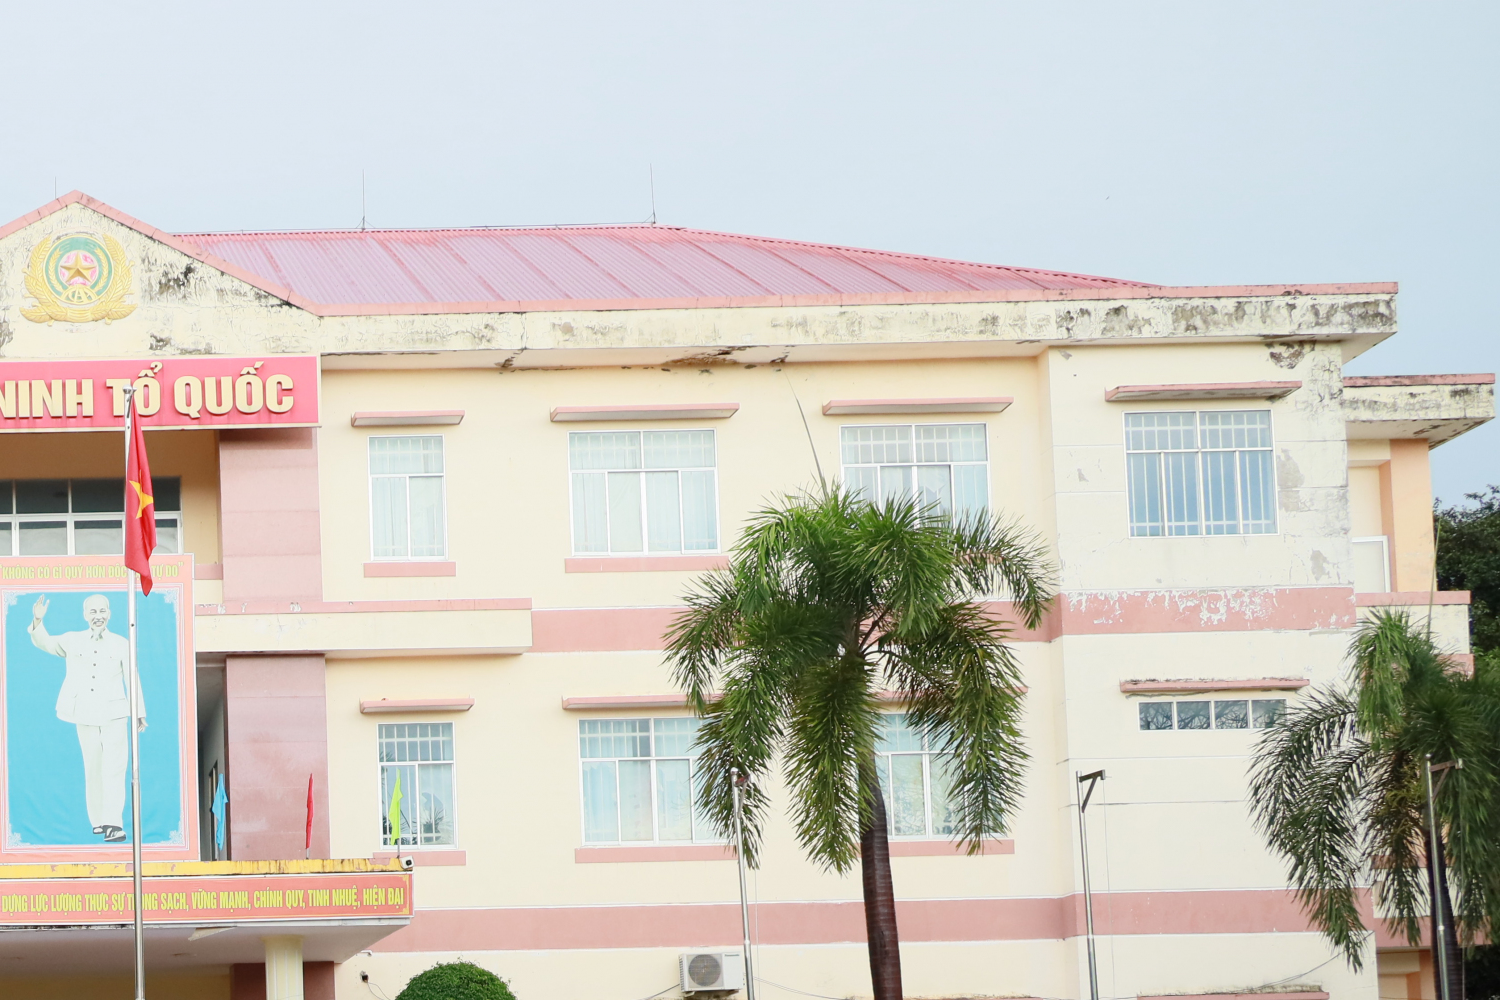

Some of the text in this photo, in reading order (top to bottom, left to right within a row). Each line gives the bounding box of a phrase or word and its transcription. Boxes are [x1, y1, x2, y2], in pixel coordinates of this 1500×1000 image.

[105, 361, 162, 417] TỔ
[173, 360, 294, 419] QUỐC
[36, 563, 50, 579] CÓ
[52, 564, 62, 579] GÌ
[65, 563, 84, 580] QUÝ
[85, 563, 106, 579] HƠN
[2, 893, 28, 916] DỰNG
[30, 892, 49, 916] LỰC
[51, 892, 83, 916] LƯỢNG
[84, 892, 109, 916] THỰC
[111, 891, 126, 915] SỰ
[160, 892, 190, 914] SẠCH,
[191, 888, 218, 910] VỮNG
[219, 890, 252, 913] MẠNH,
[253, 886, 283, 908] CHÍNH
[285, 889, 306, 910] QUY,
[308, 888, 330, 907] TINH
[332, 884, 361, 910] NHUỆ,
[363, 884, 386, 910] HIỆN
[387, 887, 405, 910] ĐẠI
